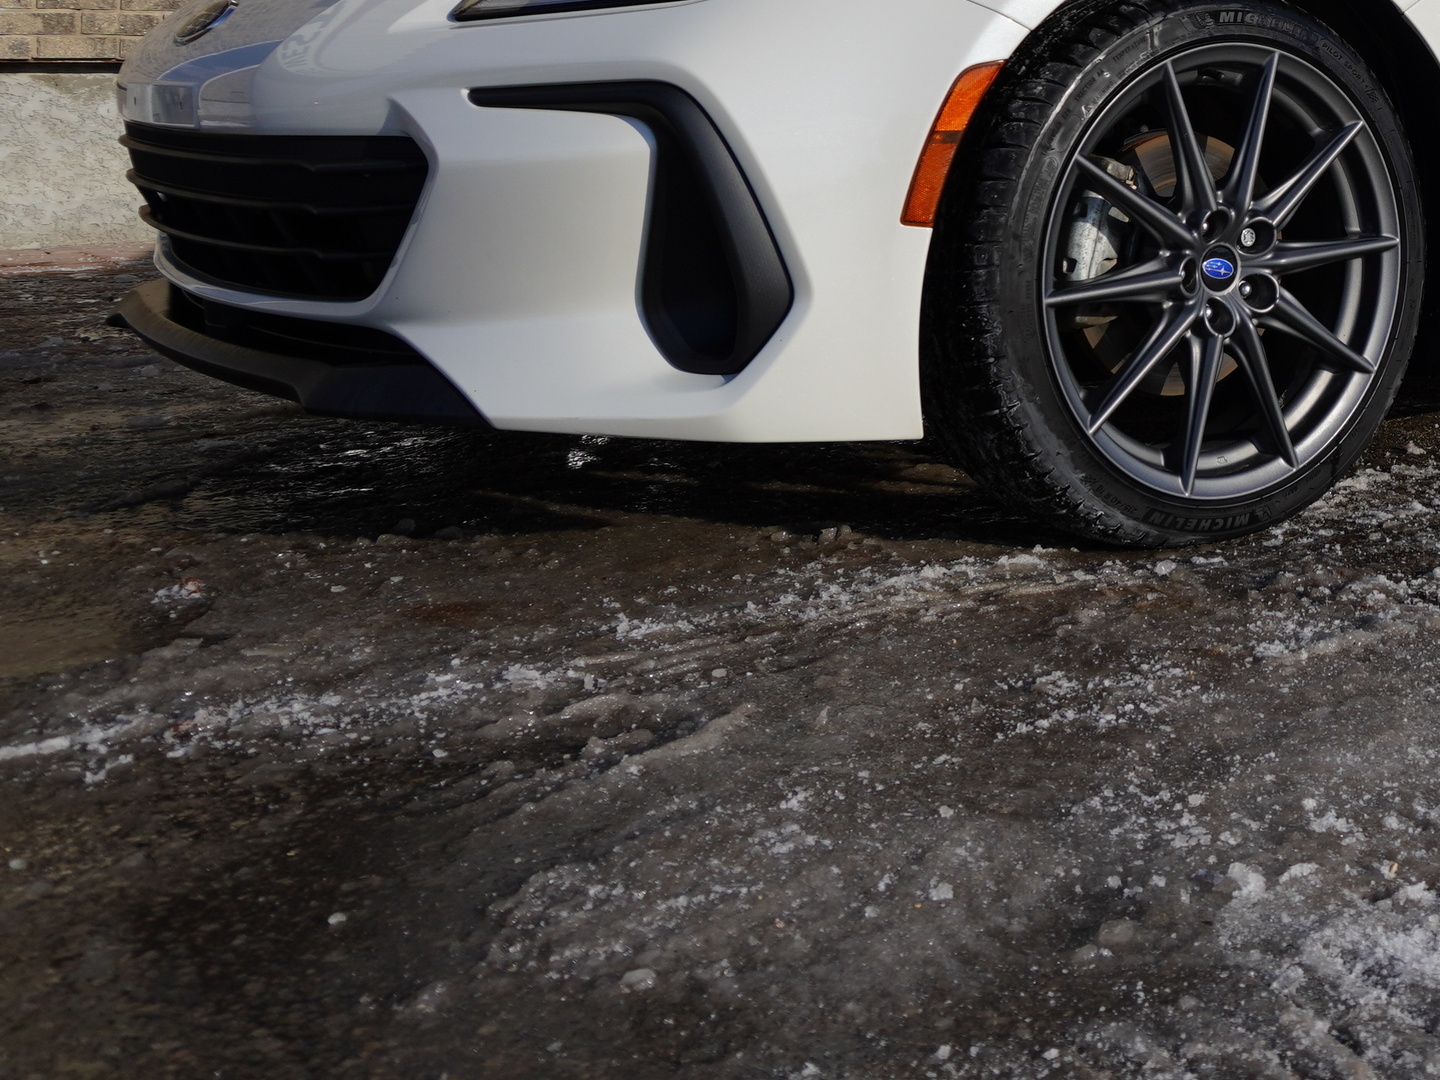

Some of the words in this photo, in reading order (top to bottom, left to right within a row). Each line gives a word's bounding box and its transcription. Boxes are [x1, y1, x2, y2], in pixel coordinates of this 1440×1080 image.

[1322, 43, 1343, 62] PILOT
[1344, 59, 1366, 85] SPORT
[1150, 511, 1250, 531] MICHELIN
